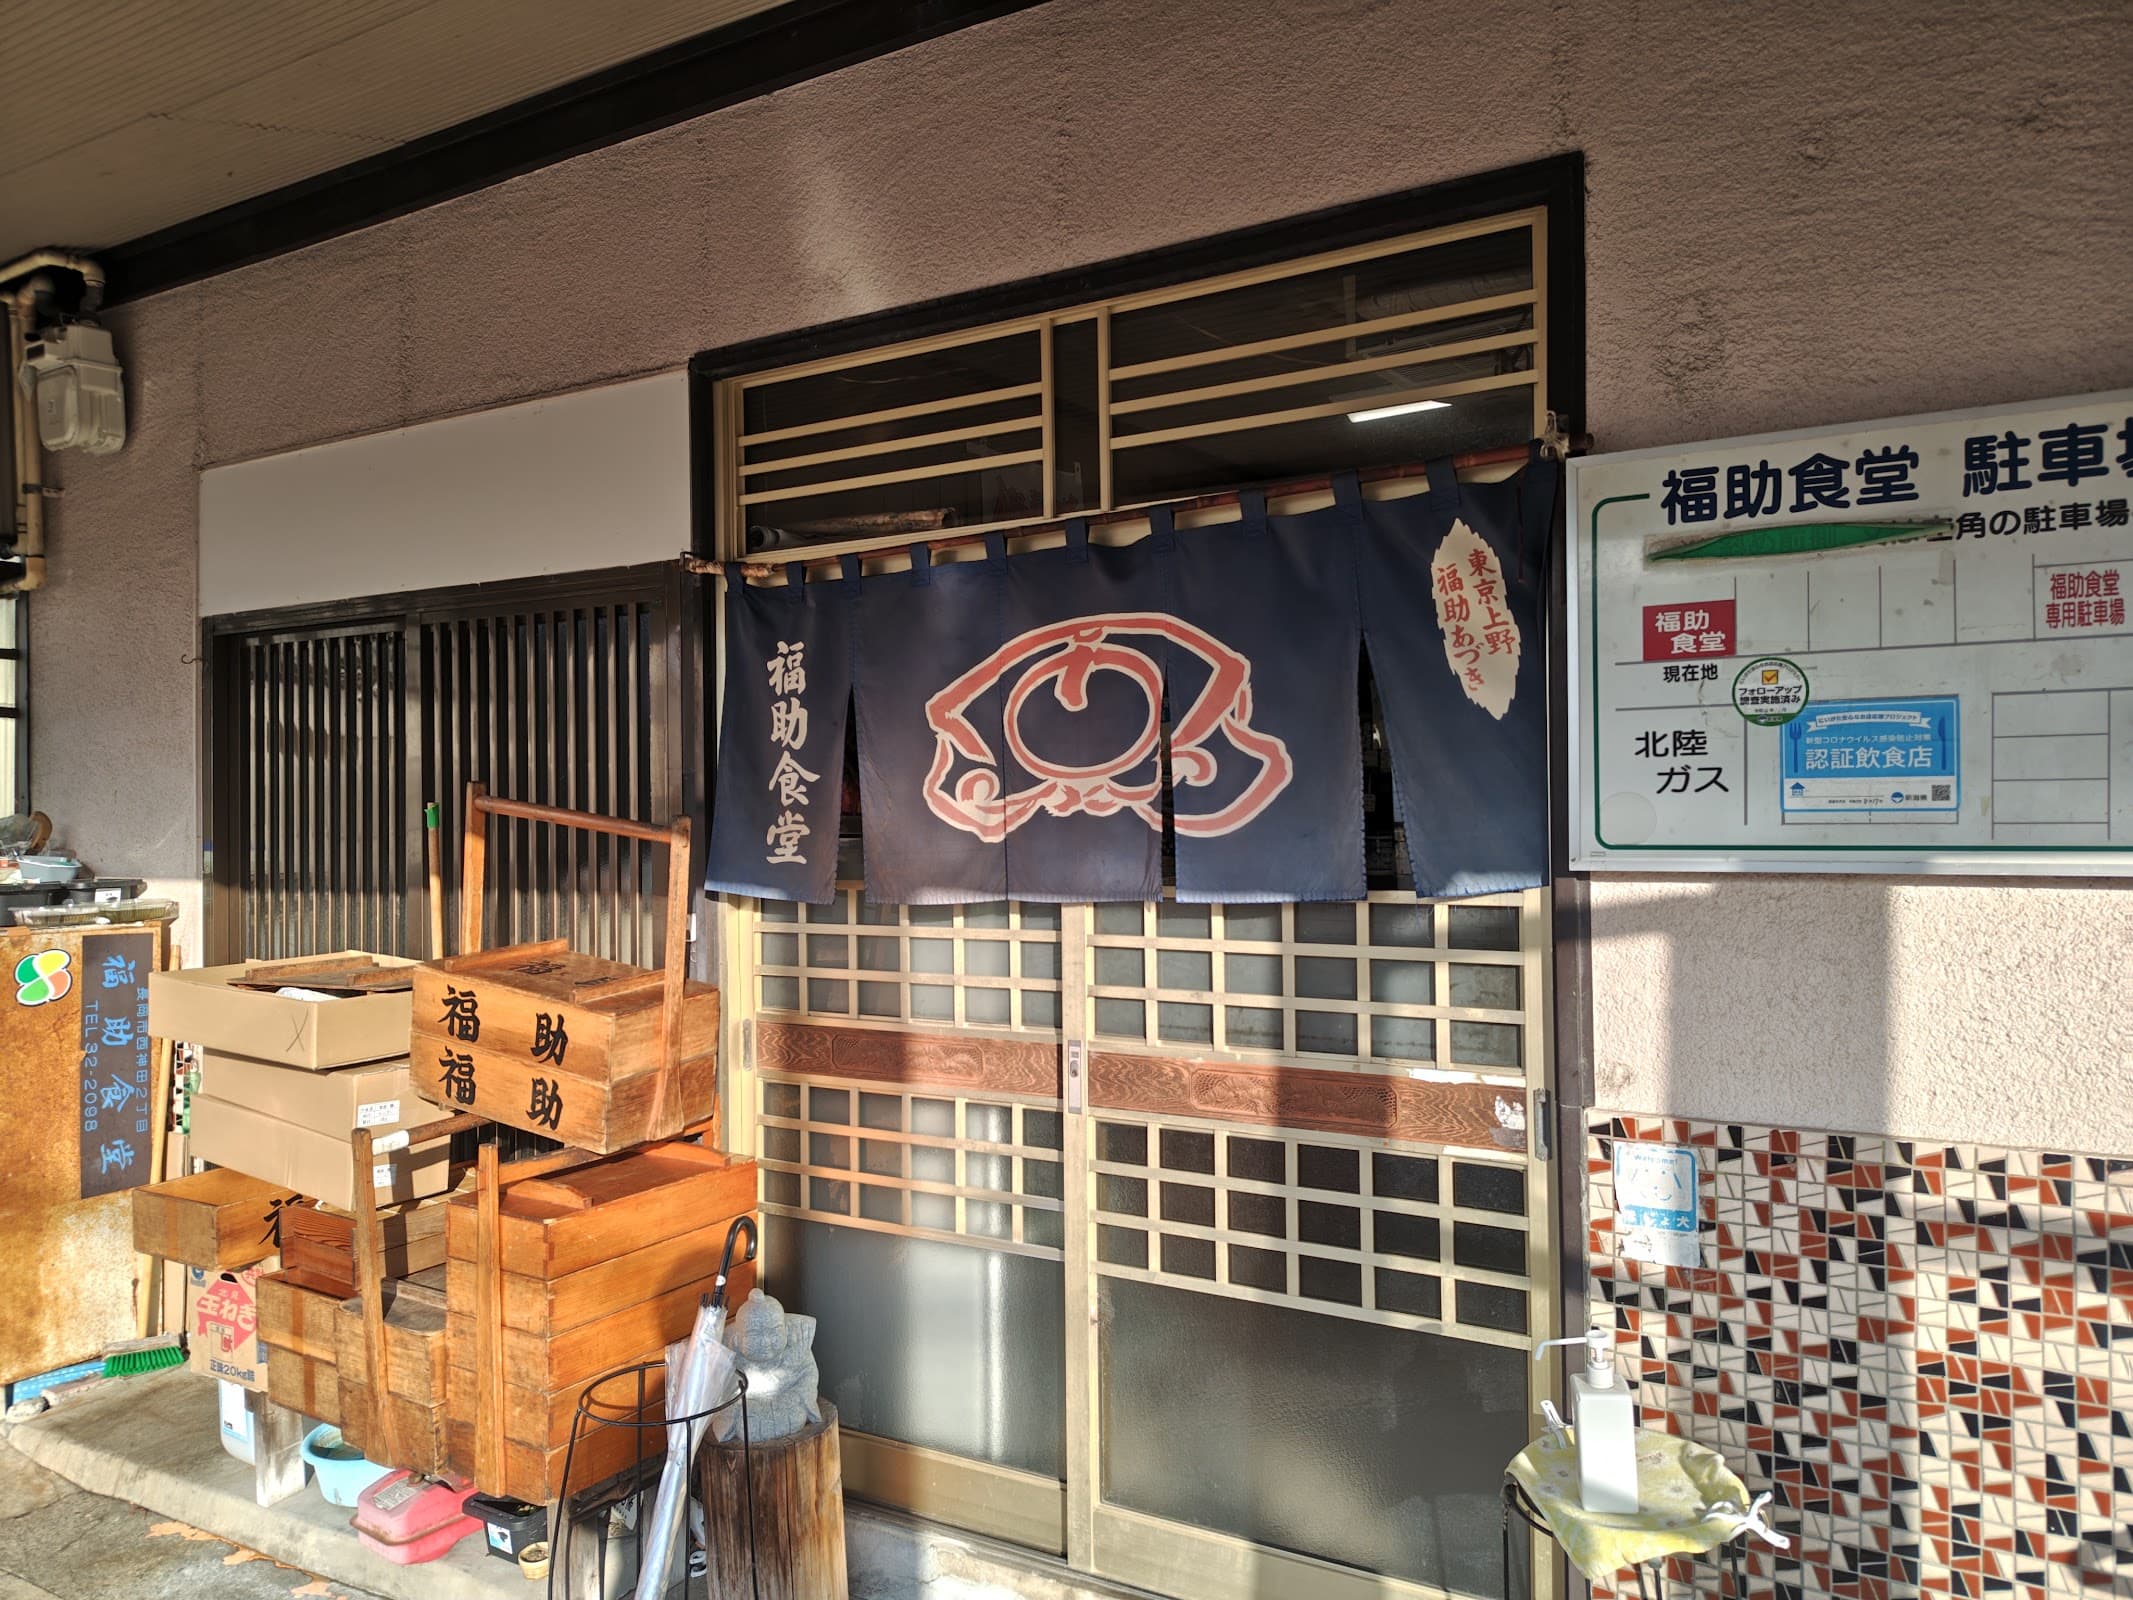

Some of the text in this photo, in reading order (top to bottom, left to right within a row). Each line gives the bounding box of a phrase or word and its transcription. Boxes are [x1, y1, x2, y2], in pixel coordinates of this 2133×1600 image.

[1660, 416, 2133, 526] 福助食堂 駐車
[2049, 569, 2121, 601] 福助食堂
[1467, 548, 1516, 656] 東京上野
[2045, 597, 2126, 629] 専用駐車場
[1437, 562, 1485, 692] 福助あづき
[1655, 609, 1710, 633] 福助
[1670, 630, 1726, 655] 食堂
[1662, 663, 1719, 683] 現在地
[1738, 685, 1803, 696] フォローアップ
[765, 640, 821, 865] 福助食堂
[1634, 729, 1709, 758] 北陸
[1805, 745, 1934, 770] 認証飲食店
[1656, 764, 1730, 795] ガス
[101, 954, 138, 1176] 福助食堂
[198, 1294, 257, 1332] 玉ねぎ
